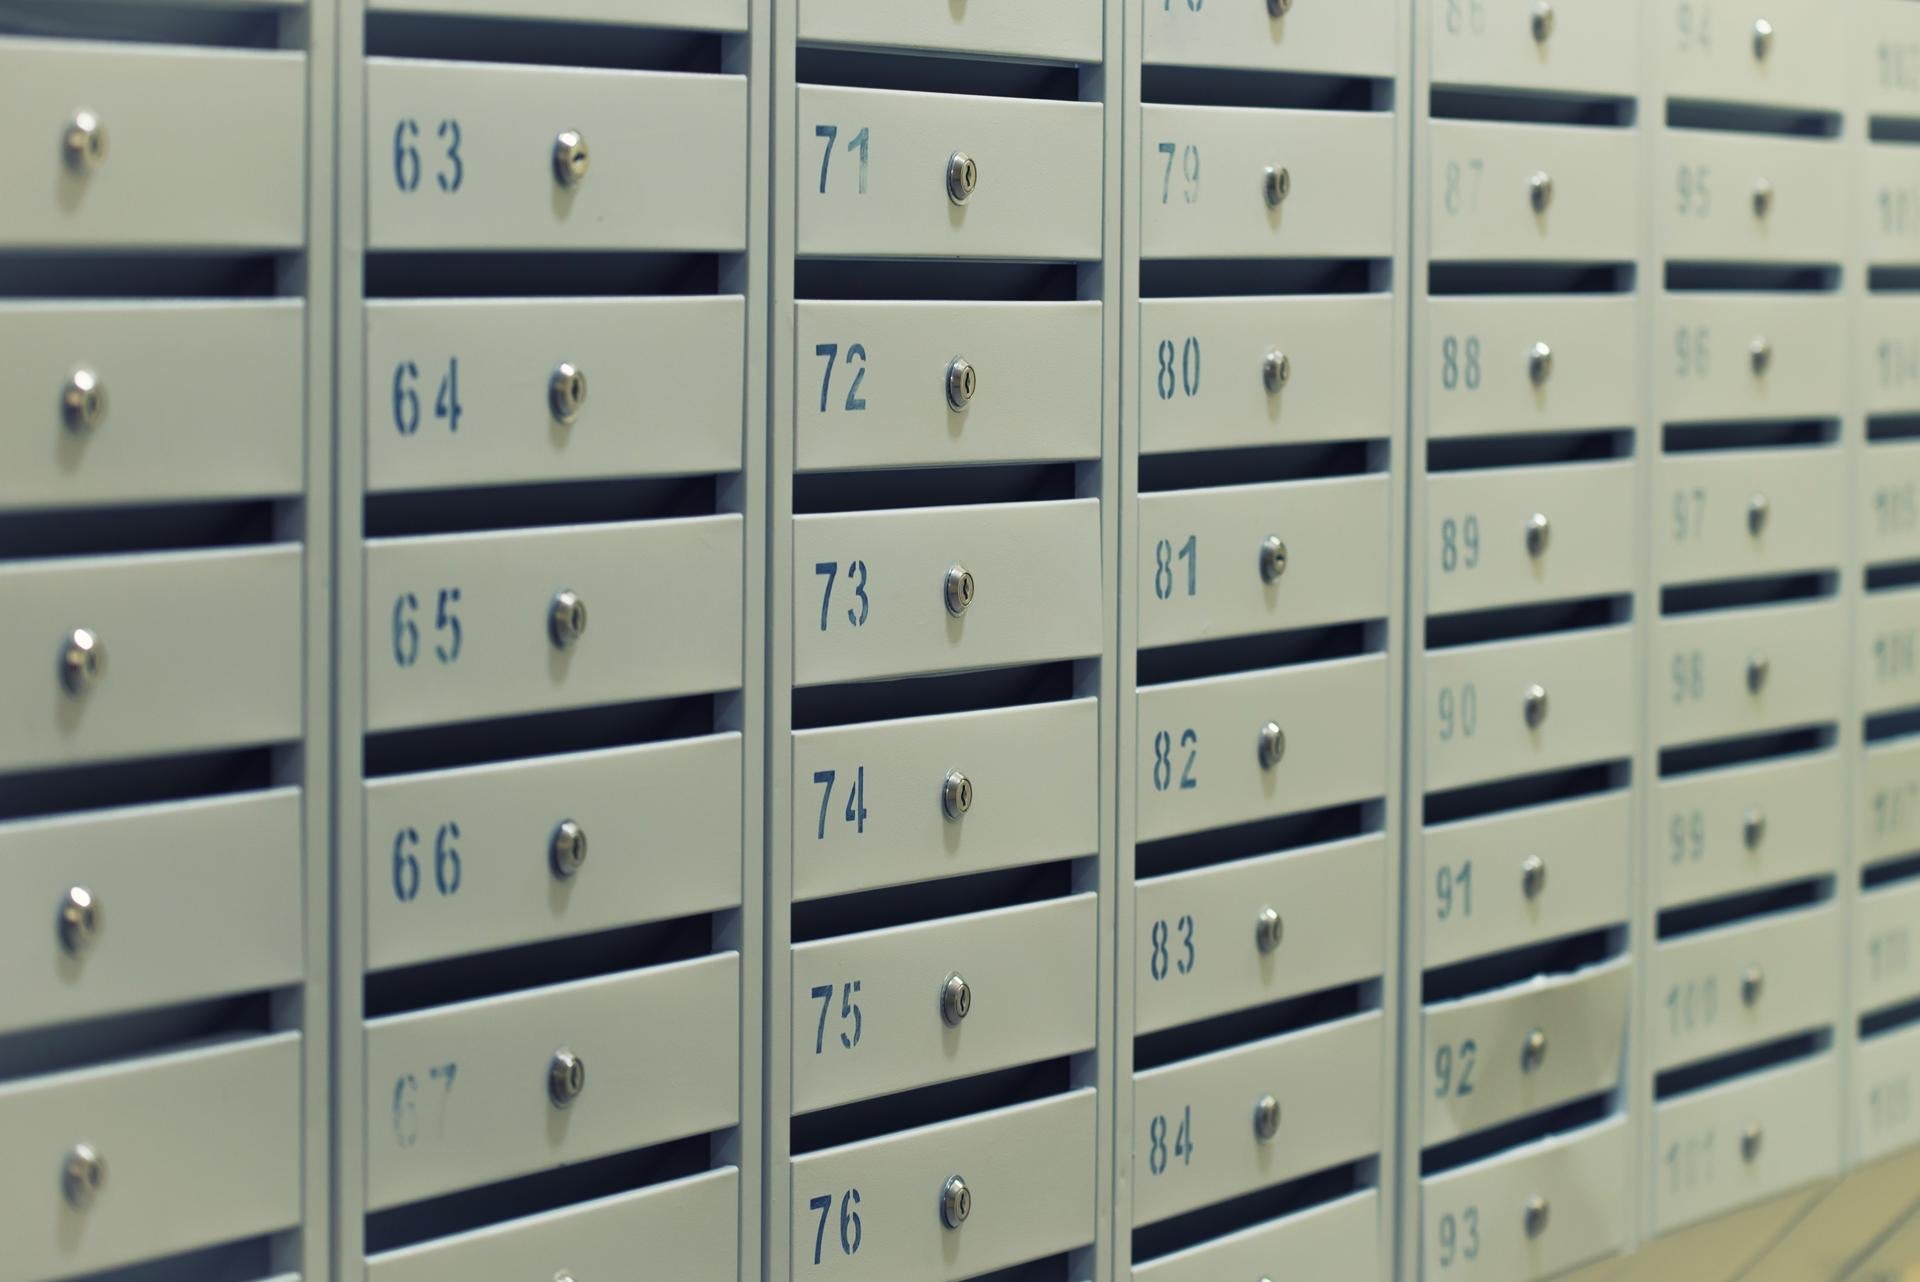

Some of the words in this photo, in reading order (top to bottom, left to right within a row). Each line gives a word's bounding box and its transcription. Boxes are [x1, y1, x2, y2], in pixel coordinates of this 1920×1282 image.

[394, 120, 463, 192] 63
[815, 125, 868, 194] 71
[1158, 142, 1199, 204] 79
[1444, 158, 1484, 216] 87
[1676, 164, 1710, 216] 95
[816, 343, 866, 412] 72
[1158, 337, 1200, 399] 80
[1442, 336, 1480, 391] 88
[1674, 326, 1710, 378] 96
[392, 358, 462, 435] 64
[1441, 515, 1480, 573] 89
[1672, 486, 1707, 543] 97
[815, 561, 868, 631] 73
[1155, 535, 1198, 599] 81
[393, 588, 462, 666] 65
[1438, 683, 1476, 742] 90
[1154, 729, 1197, 790] 82
[814, 766, 867, 839] 74
[393, 822, 461, 902] 66
[1669, 810, 1705, 865] 99
[1436, 860, 1472, 920] 91
[1151, 915, 1194, 980] 83
[811, 981, 861, 1054] 75
[1435, 1039, 1477, 1097] 92
[1149, 1106, 1193, 1175] 84
[810, 1189, 861, 1265] 76
[1439, 1206, 1480, 1268] 93
